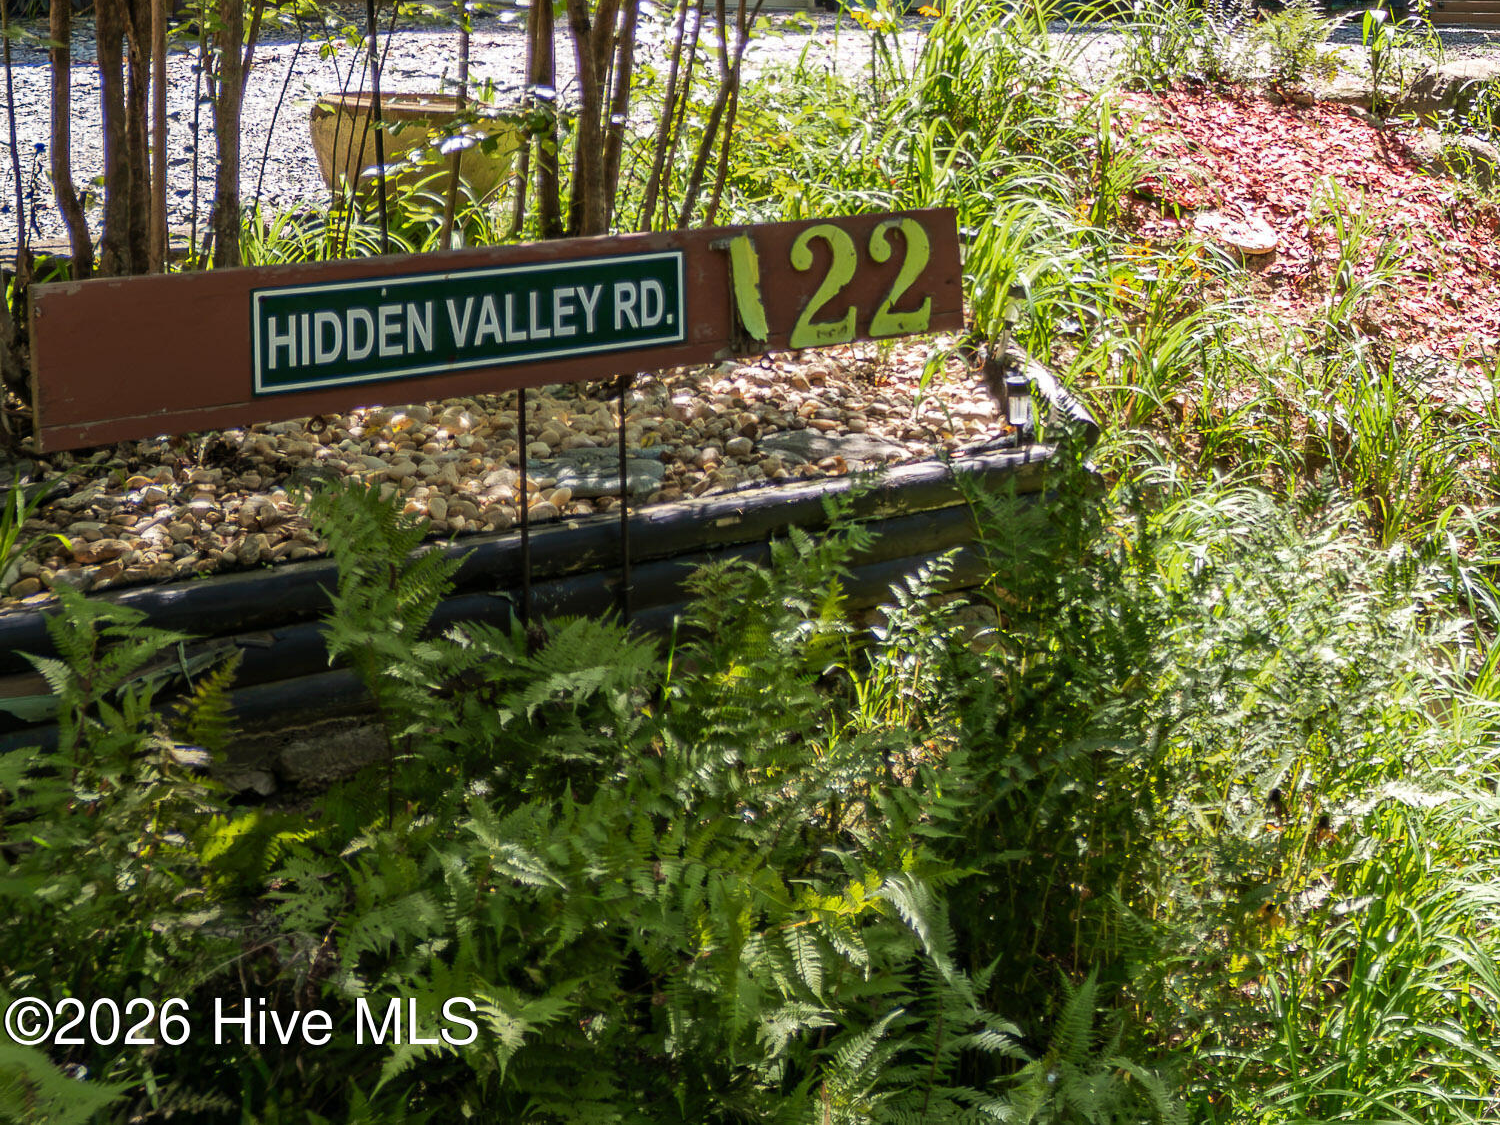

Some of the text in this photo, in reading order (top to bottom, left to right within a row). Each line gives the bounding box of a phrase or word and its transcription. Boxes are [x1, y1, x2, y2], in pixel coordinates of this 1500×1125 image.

[267, 279, 673, 369] HIDDEN VALLEY RD.
[711, 217, 931, 351] 122
